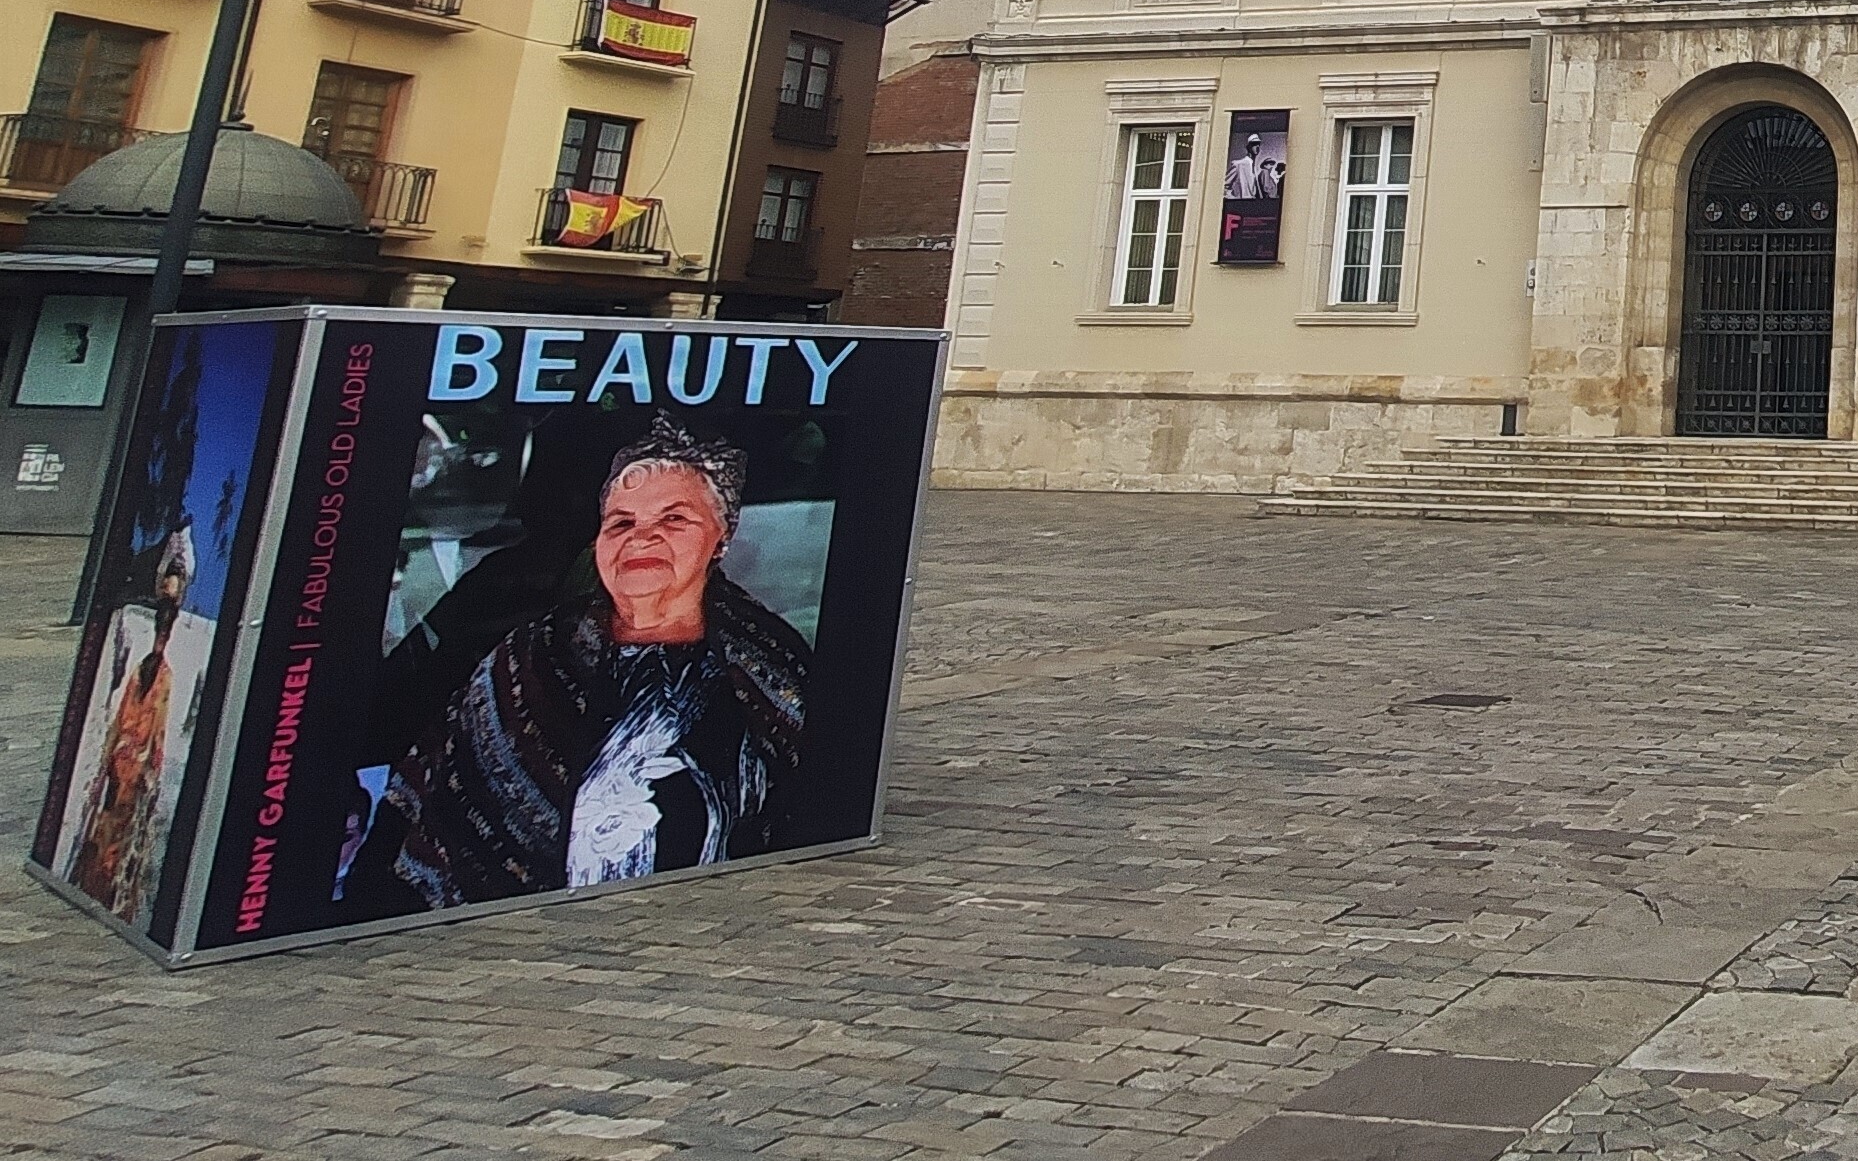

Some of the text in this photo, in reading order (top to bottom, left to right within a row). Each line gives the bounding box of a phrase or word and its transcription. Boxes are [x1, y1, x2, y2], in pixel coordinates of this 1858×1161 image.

[1224, 213, 1242, 241] F
[336, 342, 374, 427] LADIES
[427, 324, 859, 405] BEAUTY
[325, 432, 356, 487] OLD
[296, 492, 345, 628] FABULOUS
[258, 656, 314, 827] GARFUNKEL
[236, 836, 278, 933] HENNY
